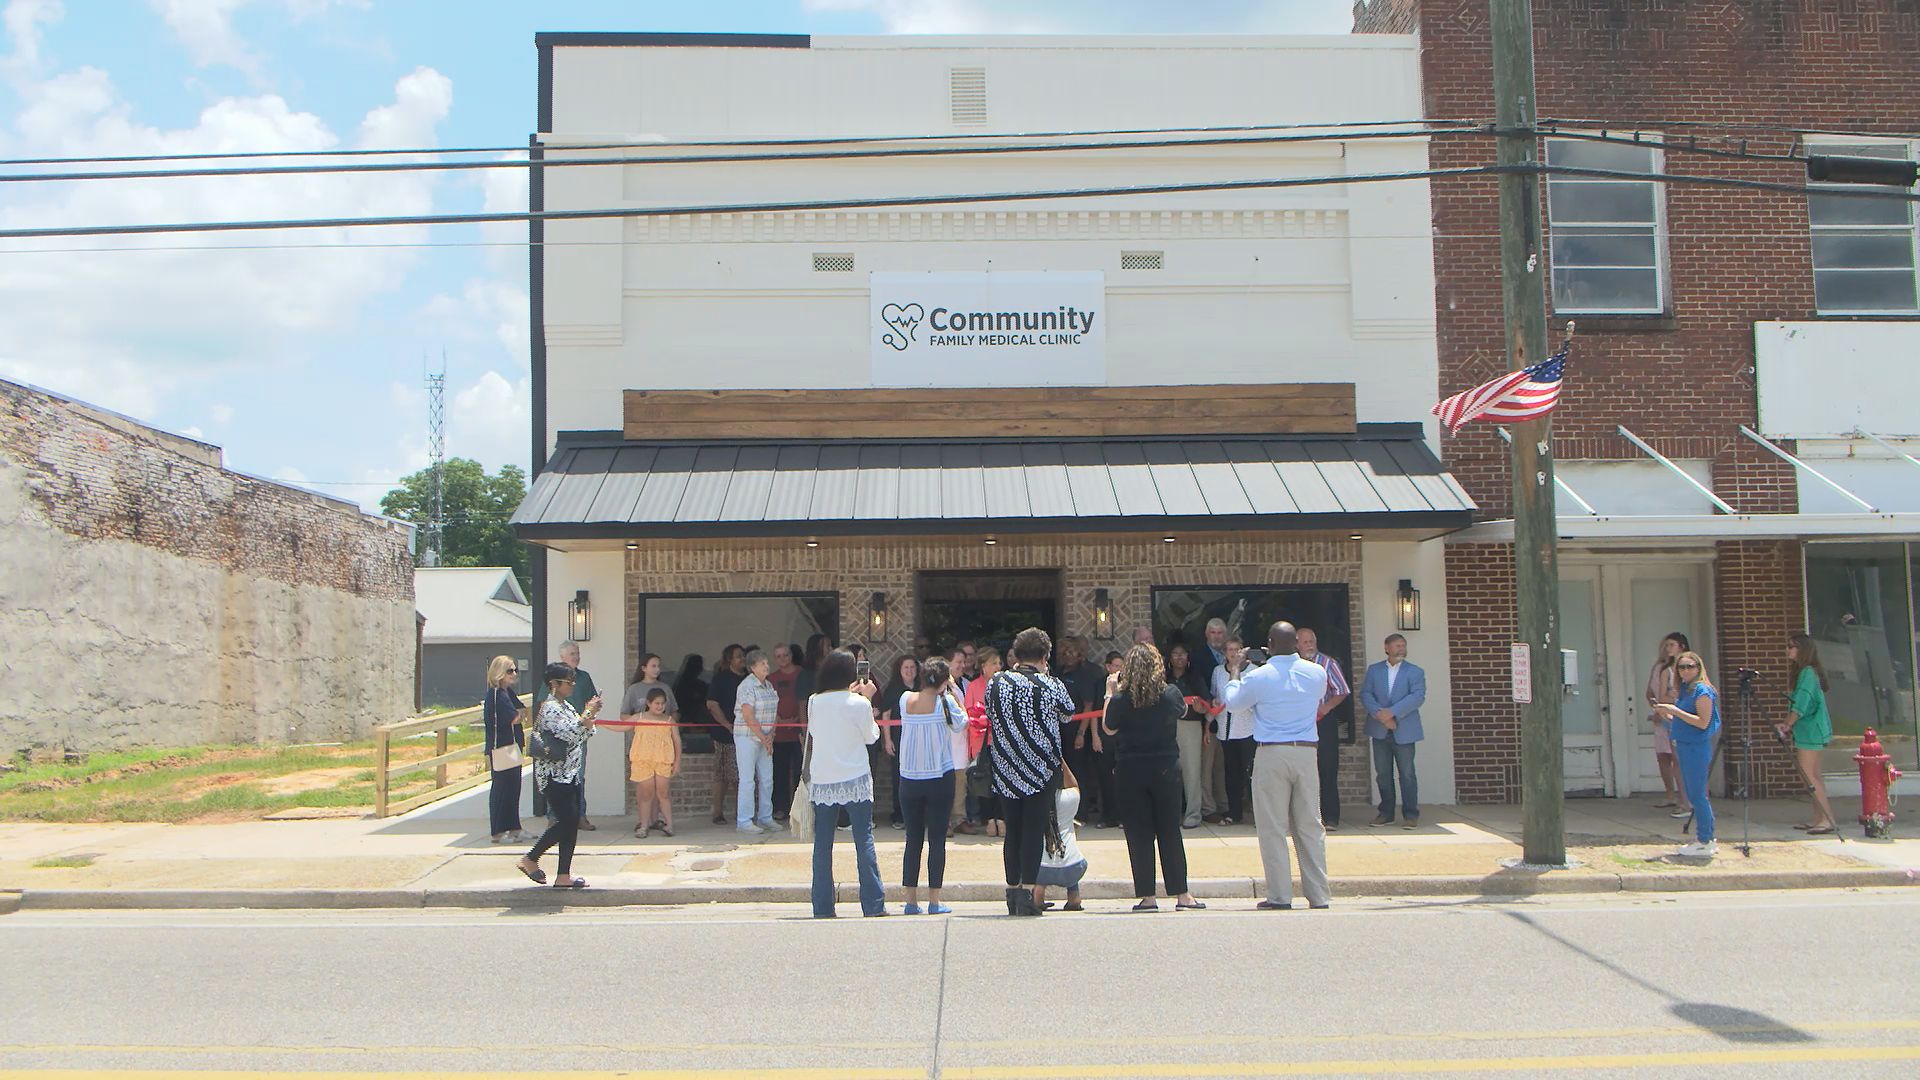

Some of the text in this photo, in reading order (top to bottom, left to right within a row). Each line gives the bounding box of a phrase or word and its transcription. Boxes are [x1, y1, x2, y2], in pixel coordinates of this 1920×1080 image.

[930, 306, 1095, 334] Community
[930, 333, 1081, 346] FAMILY MEDICAL CLINIC
